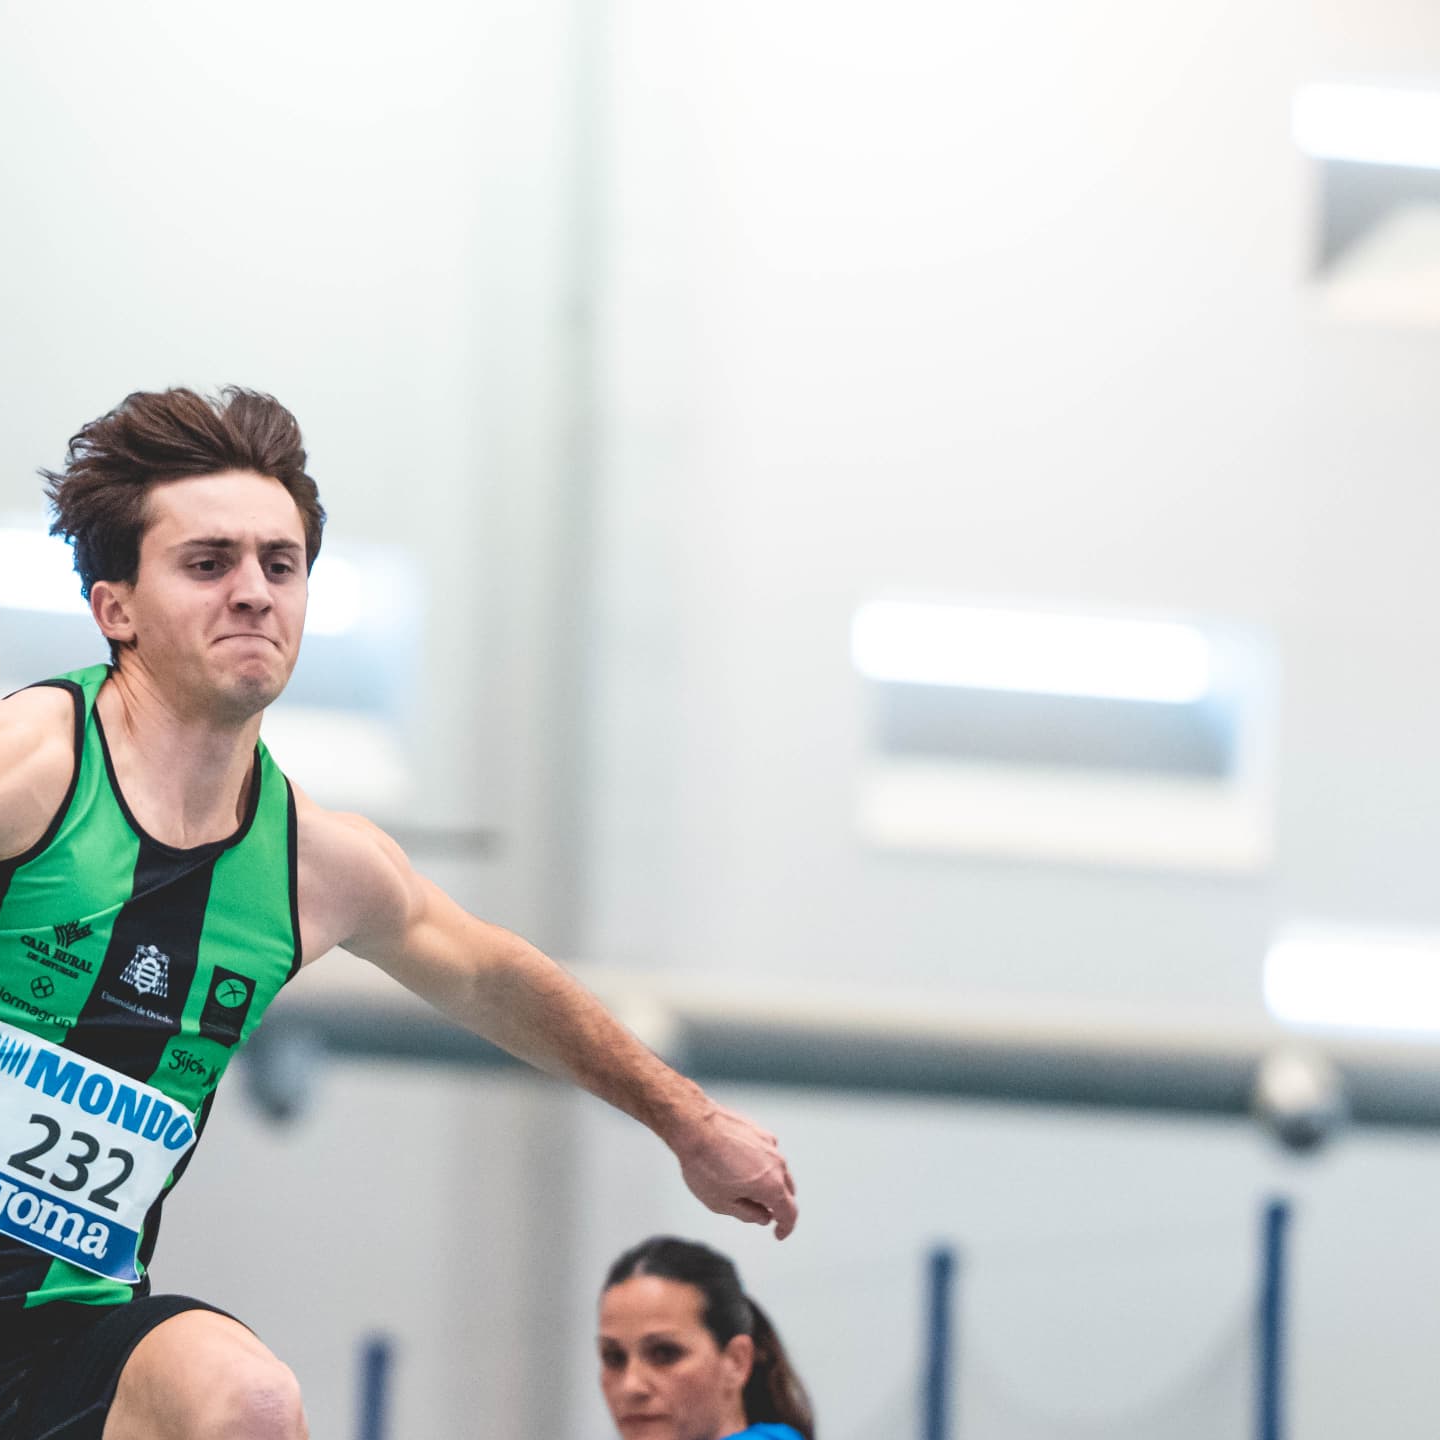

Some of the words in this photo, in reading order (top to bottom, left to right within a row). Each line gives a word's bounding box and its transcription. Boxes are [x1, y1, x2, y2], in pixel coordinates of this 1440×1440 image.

[53, 949, 93, 974] RURAL
[25, 1049, 193, 1151] MONDO
[7, 1114, 134, 1211] 232
